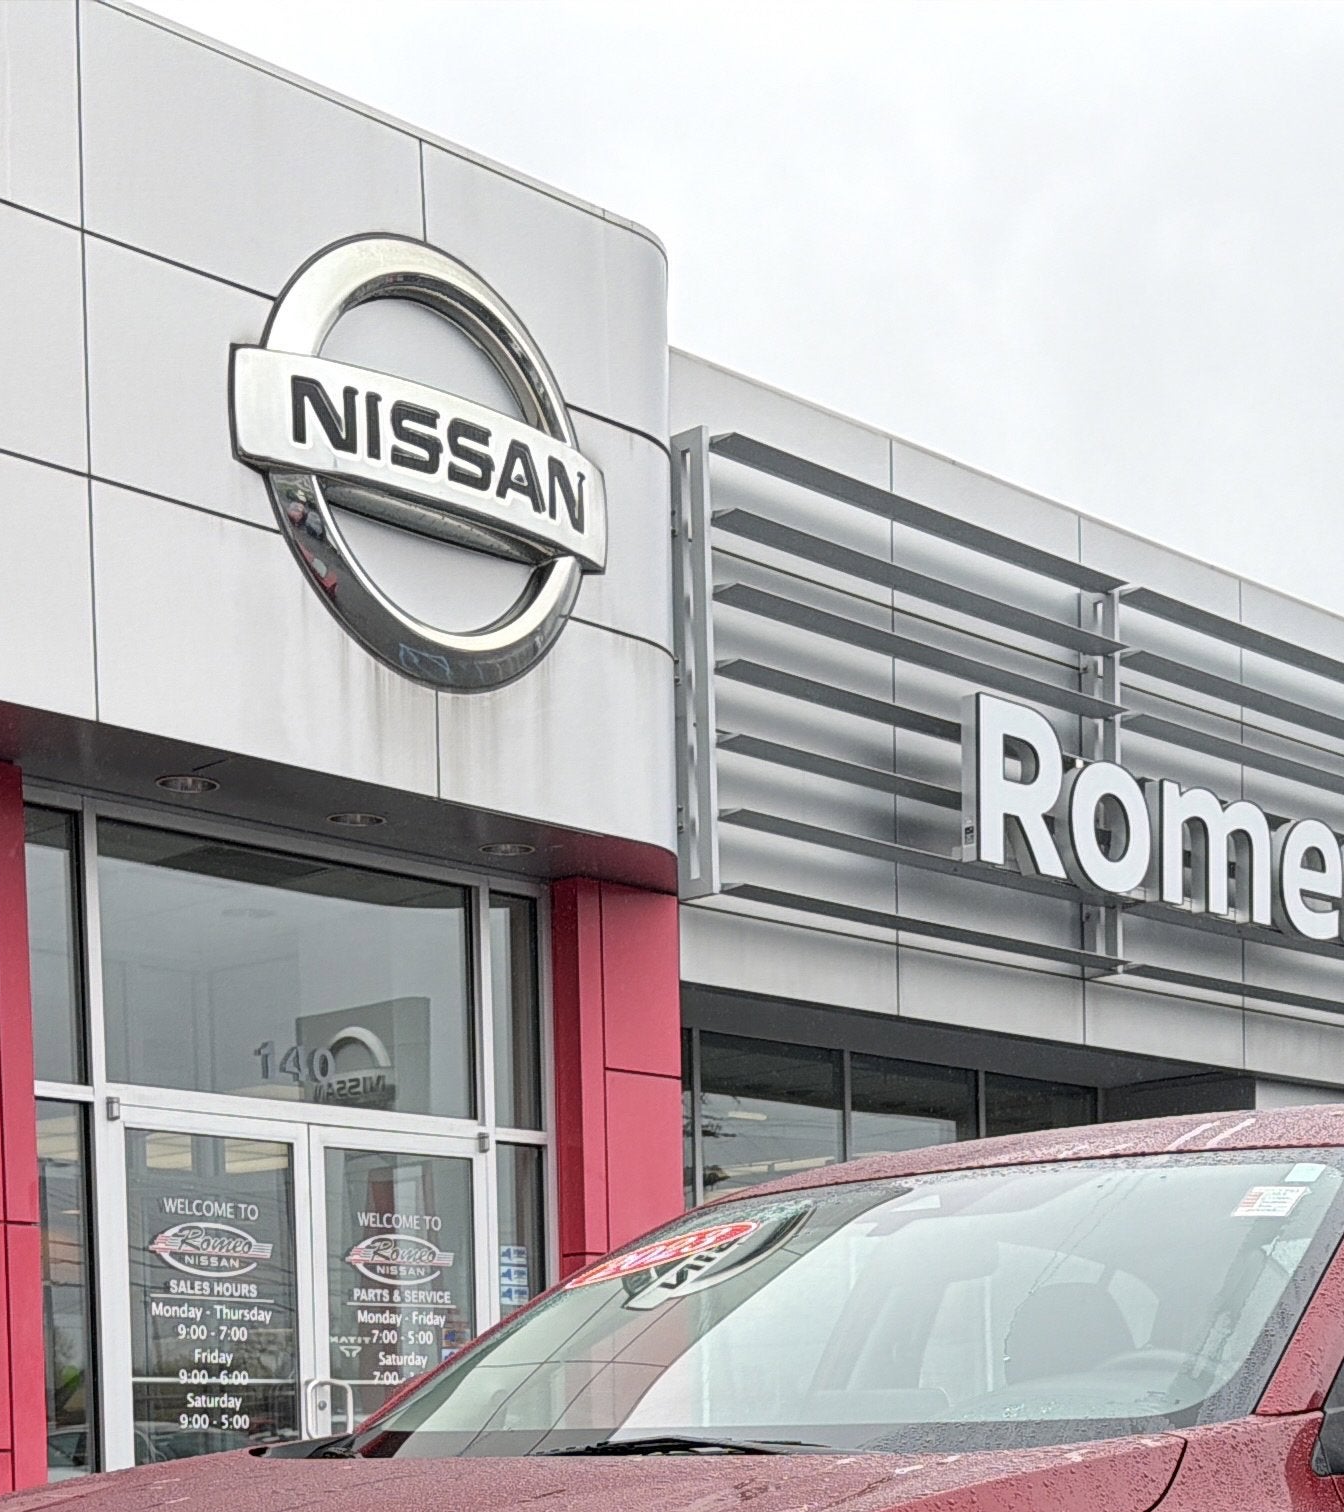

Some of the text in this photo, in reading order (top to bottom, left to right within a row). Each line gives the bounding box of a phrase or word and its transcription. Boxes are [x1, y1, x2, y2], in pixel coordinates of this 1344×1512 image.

[290, 374, 586, 535] NISSAN
[254, 1040, 336, 1082] 140
[163, 1197, 259, 1221] WELCOME TO
[357, 1211, 442, 1231] WELCOME TO
[174, 1225, 253, 1254] Romeo
[368, 1238, 437, 1262] Romeo
[184, 1255, 240, 1268] NISSAN
[376, 1265, 425, 1277] NISSAN
[169, 1279, 258, 1298] SALES HOURS
[353, 1287, 452, 1304] PARTS & SERVICE
[151, 1302, 203, 1322] Monday
[213, 1304, 273, 1325] Thursday
[357, 1309, 403, 1328] Monday
[412, 1311, 446, 1328] Friday
[177, 1324, 208, 1340] 9:00
[218, 1325, 248, 1341] 7:00
[371, 1329, 398, 1345] 7:00
[408, 1331, 434, 1345] 5:00
[194, 1348, 234, 1367] Friday
[378, 1351, 428, 1369] Saturday
[178, 1369, 209, 1385] 9:00
[219, 1370, 249, 1386] 6:00
[372, 1371, 399, 1385] 7:00
[186, 1392, 243, 1411] Saturday
[179, 1414, 210, 1430] 9:00
[221, 1414, 250, 1430] 5:00
